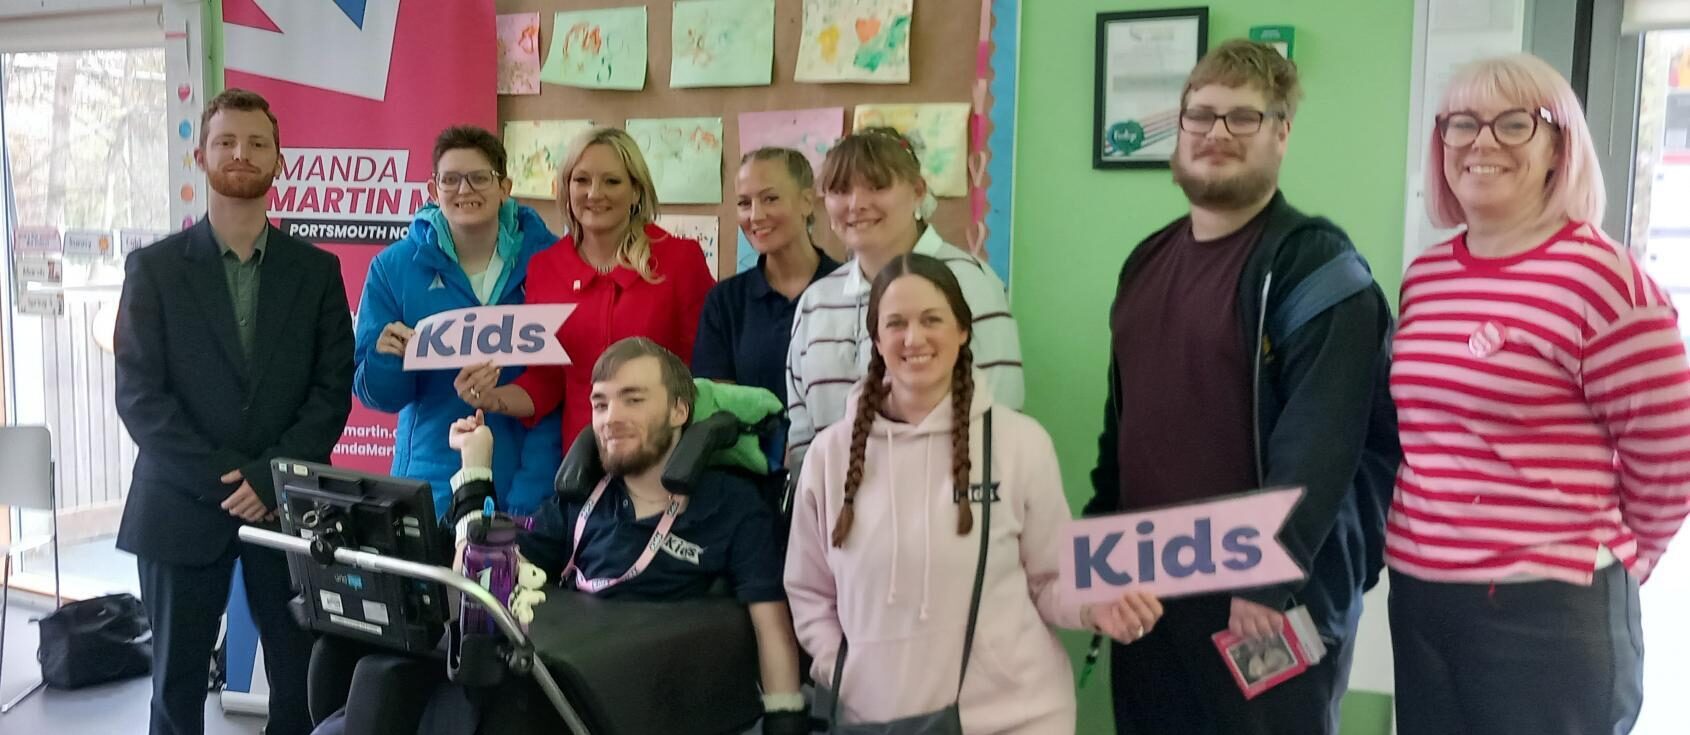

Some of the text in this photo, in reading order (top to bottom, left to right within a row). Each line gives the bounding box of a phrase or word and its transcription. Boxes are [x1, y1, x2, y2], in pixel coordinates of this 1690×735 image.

[276, 154, 398, 183] MANDA
[266, 186, 402, 215] MARTIN
[289, 224, 410, 240] PORTSMOUTH NO
[416, 313, 546, 357] Kids
[343, 424, 397, 439] martin.
[1073, 517, 1263, 590] Kids
